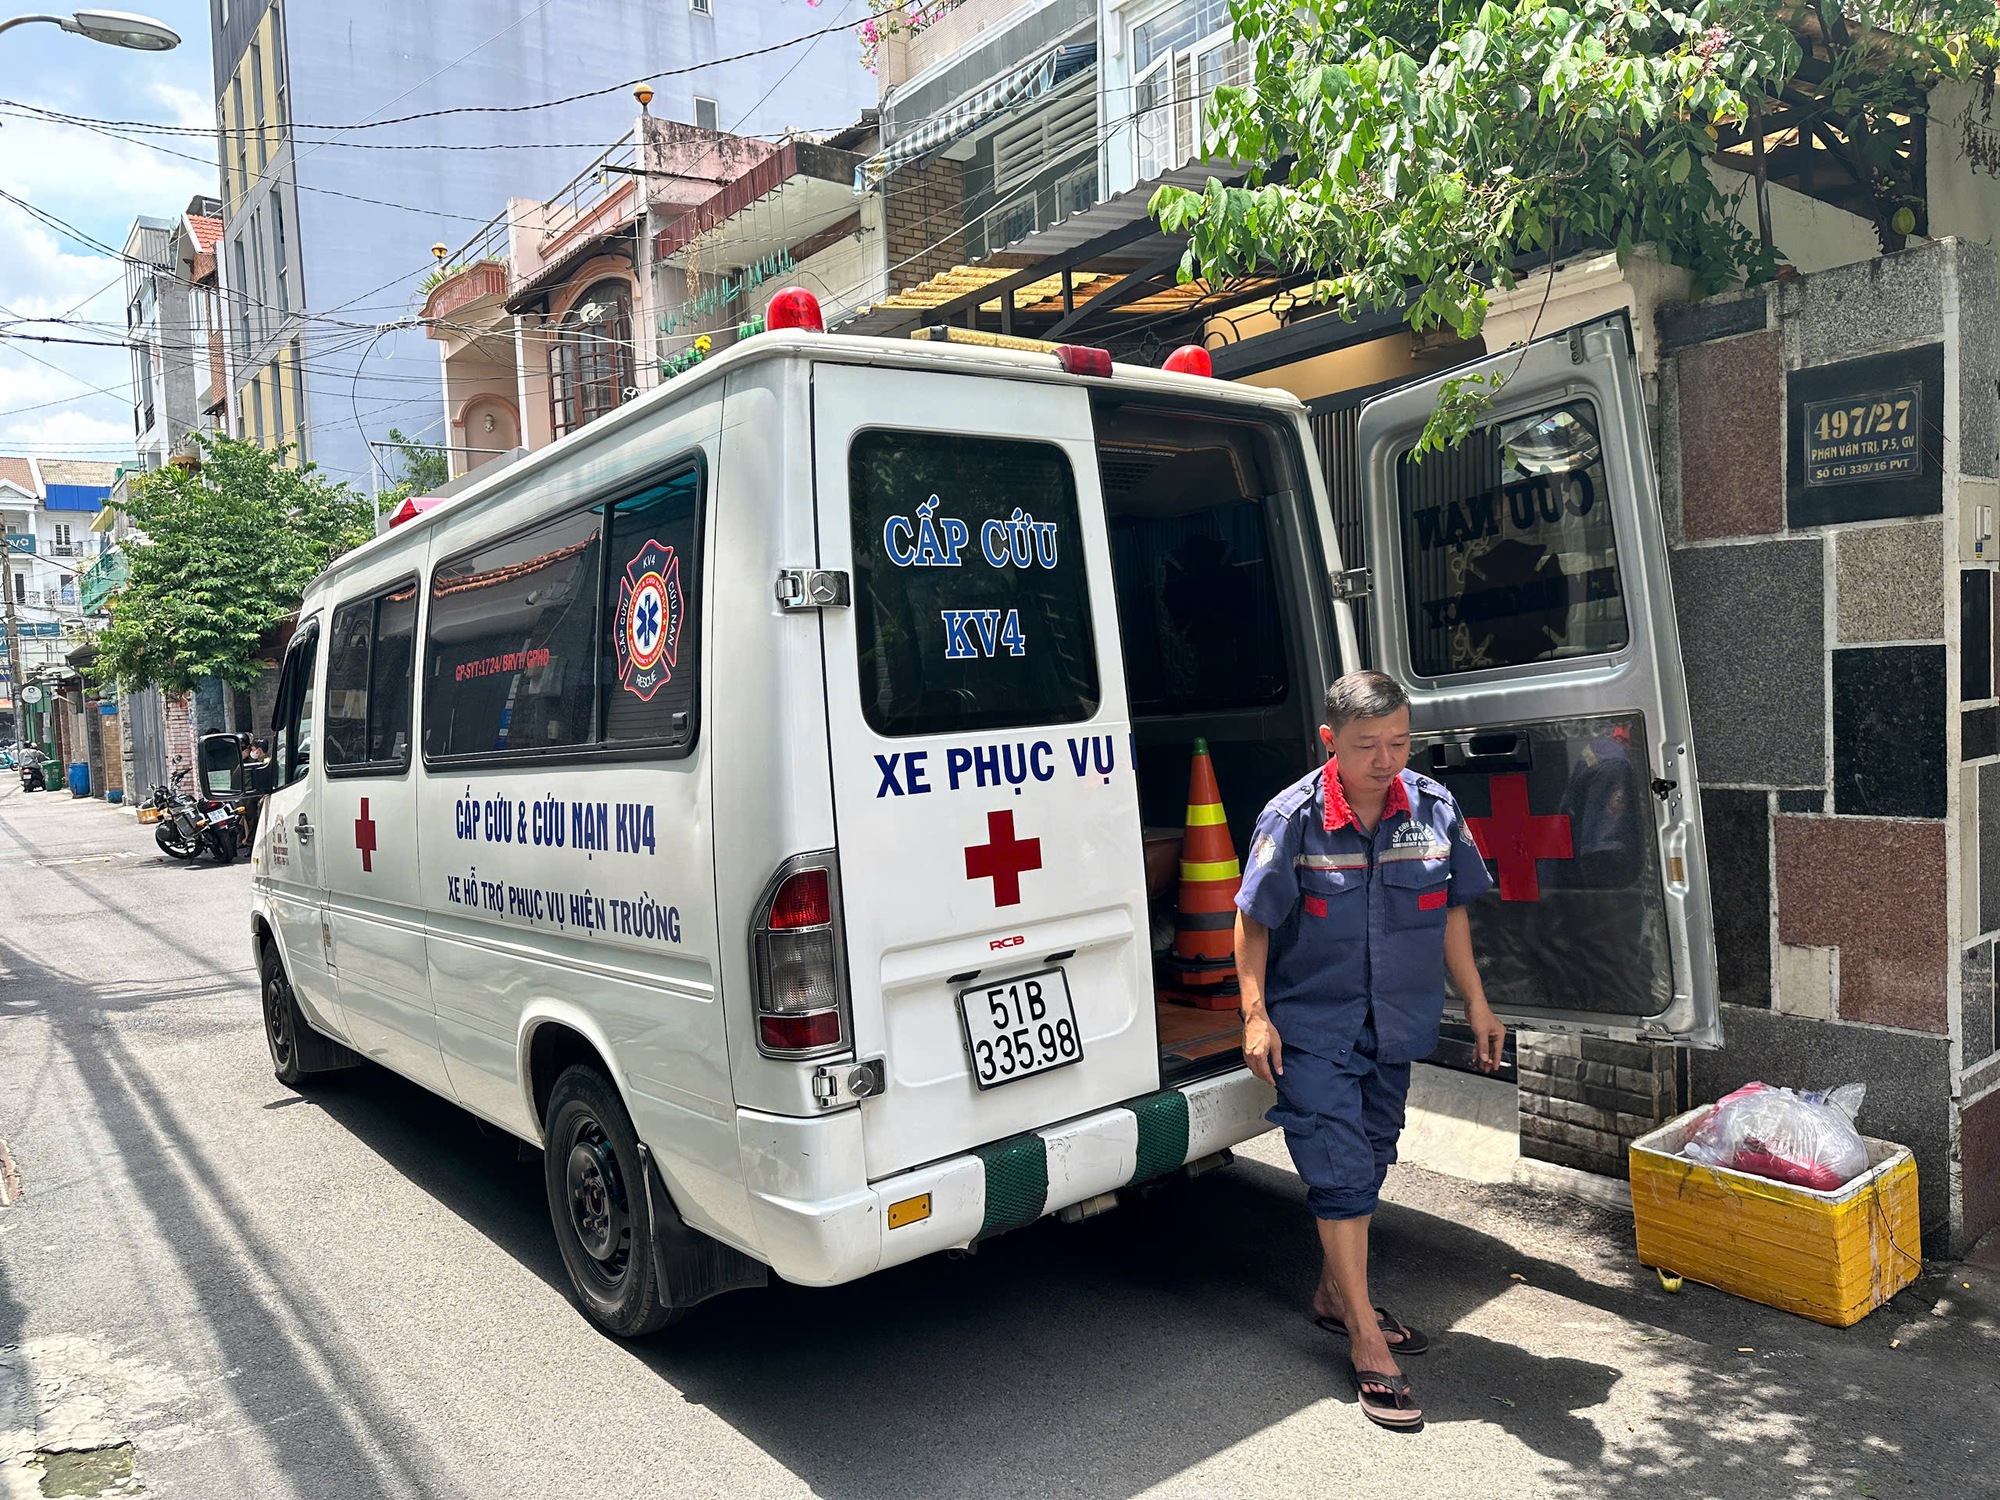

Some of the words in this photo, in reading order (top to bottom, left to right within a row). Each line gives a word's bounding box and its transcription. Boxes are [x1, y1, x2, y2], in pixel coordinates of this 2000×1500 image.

[1814, 400, 1912, 440] 497/27
[1811, 446, 1837, 461] PHAN
[1861, 440, 1880, 455] TRỊ,
[1882, 438, 1899, 451] P.5,
[1902, 436, 1914, 447] GV
[1889, 459, 1910, 470] PVT
[883, 494, 969, 567] CẤP
[981, 507, 1058, 569] CỨU
[643, 555, 656, 570] KV4
[941, 609, 1026, 659] KV4
[635, 669, 657, 688] RESCUE
[873, 750, 932, 798] XE
[946, 741, 1055, 795] PHỤC
[1067, 735, 1115, 785] VỤ
[456, 785, 480, 840] CẤP
[485, 792, 512, 843] CỨU
[518, 801, 527, 844] &
[533, 792, 565, 848] CỨU
[572, 802, 609, 860] NẠN
[616, 803, 656, 856] KV4
[1405, 833, 1424, 842] KV4
[447, 875, 461, 904] XE
[463, 866, 478, 907] HỖ
[481, 880, 504, 919] TRỢ
[508, 886, 543, 924] PHỤC
[545, 891, 565, 931] VỤ
[570, 889, 606, 937] HIỆN
[610, 891, 681, 944] TRƯỜNG
[989, 935, 1025, 951] RCB
[987, 980, 1046, 1030] 51B
[976, 1018, 1076, 1081] 335.98
